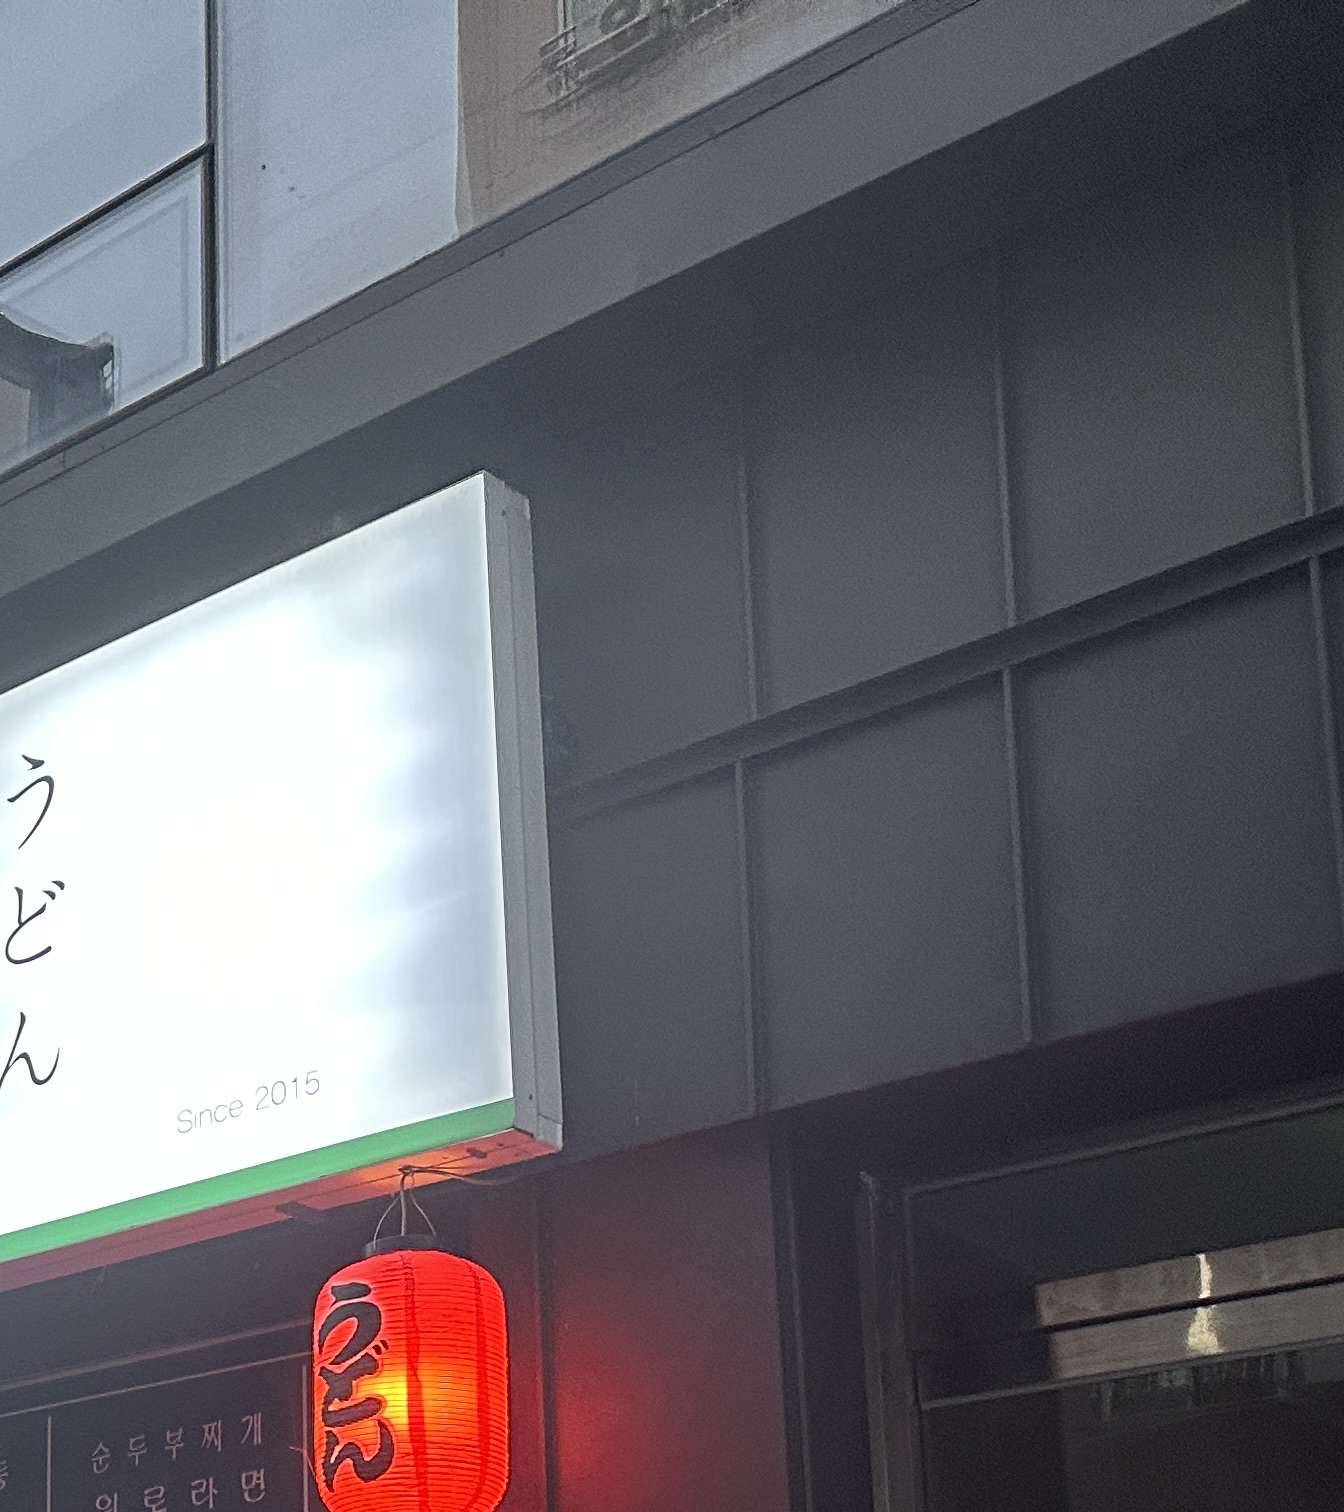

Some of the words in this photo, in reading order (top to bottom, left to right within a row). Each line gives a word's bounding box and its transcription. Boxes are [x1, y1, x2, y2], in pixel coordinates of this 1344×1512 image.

[177, 1098, 244, 1134] Since
[254, 1069, 321, 1111] 2015
[318, 1282, 395, 1493] うどん
[89, 1411, 264, 1473] 순두부찌개
